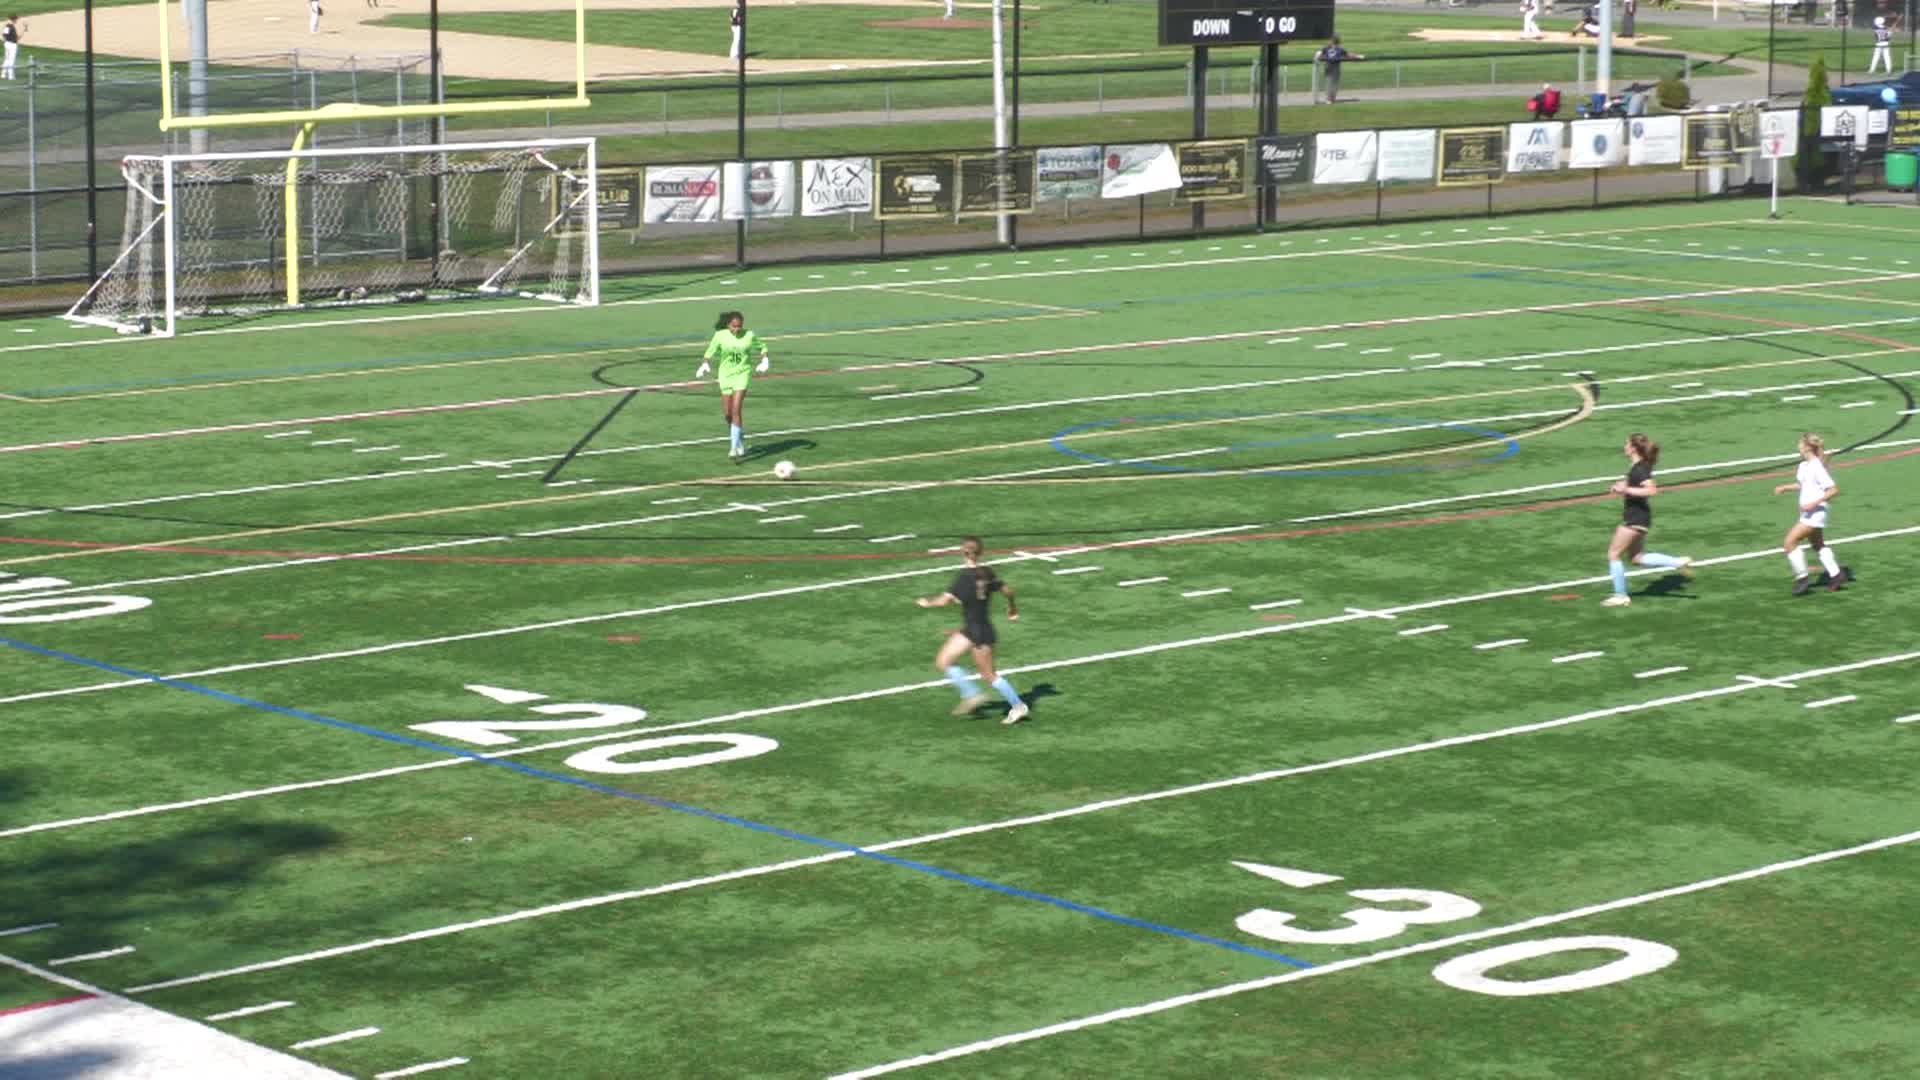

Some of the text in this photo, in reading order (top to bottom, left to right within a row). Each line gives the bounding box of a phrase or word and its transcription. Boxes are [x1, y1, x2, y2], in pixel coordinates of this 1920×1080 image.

[1193, 16, 1296, 36] DOWN O GO
[811, 188, 866, 204] ON MAIN
